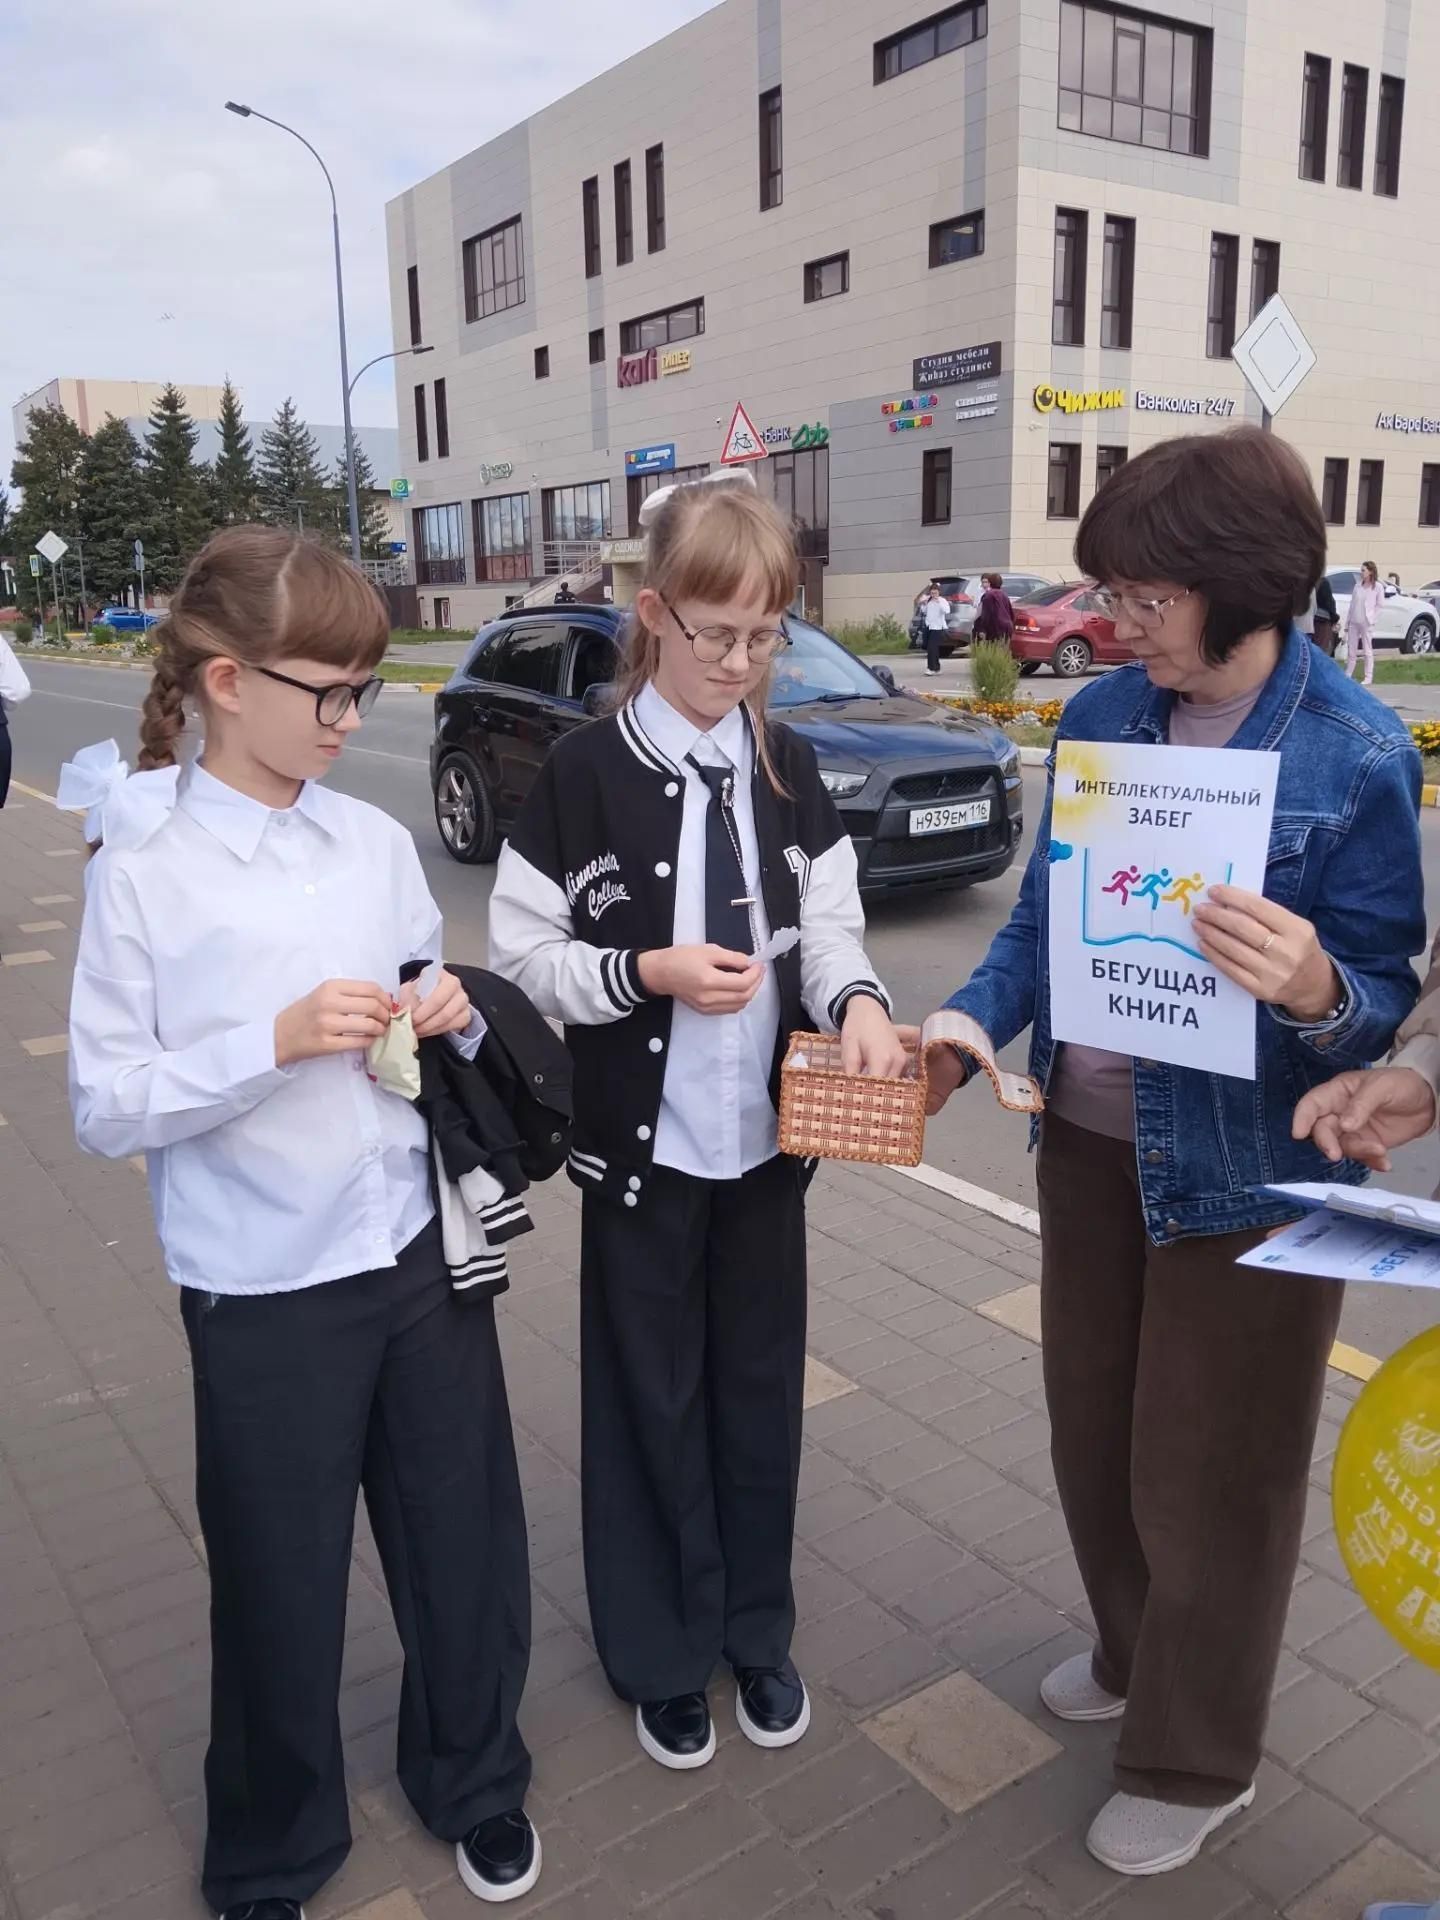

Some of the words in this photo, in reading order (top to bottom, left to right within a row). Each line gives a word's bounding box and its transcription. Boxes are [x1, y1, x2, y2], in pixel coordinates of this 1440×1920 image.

[1135, 390, 1203, 414] Банкомат
[1205, 397, 1237, 416] 24/7
[1375, 411, 1392, 430] Ак
[1393, 413, 1421, 434] Барс
[1074, 779, 1262, 807] ИНТЕЛЛЕКТУАЛЬНЫЙ
[969, 802, 988, 817] 116
[1128, 807, 1193, 829] ЗАБЕГ
[1091, 957, 1217, 998] БЕГУЩАЯ
[1108, 992, 1200, 1030] КНИГА
